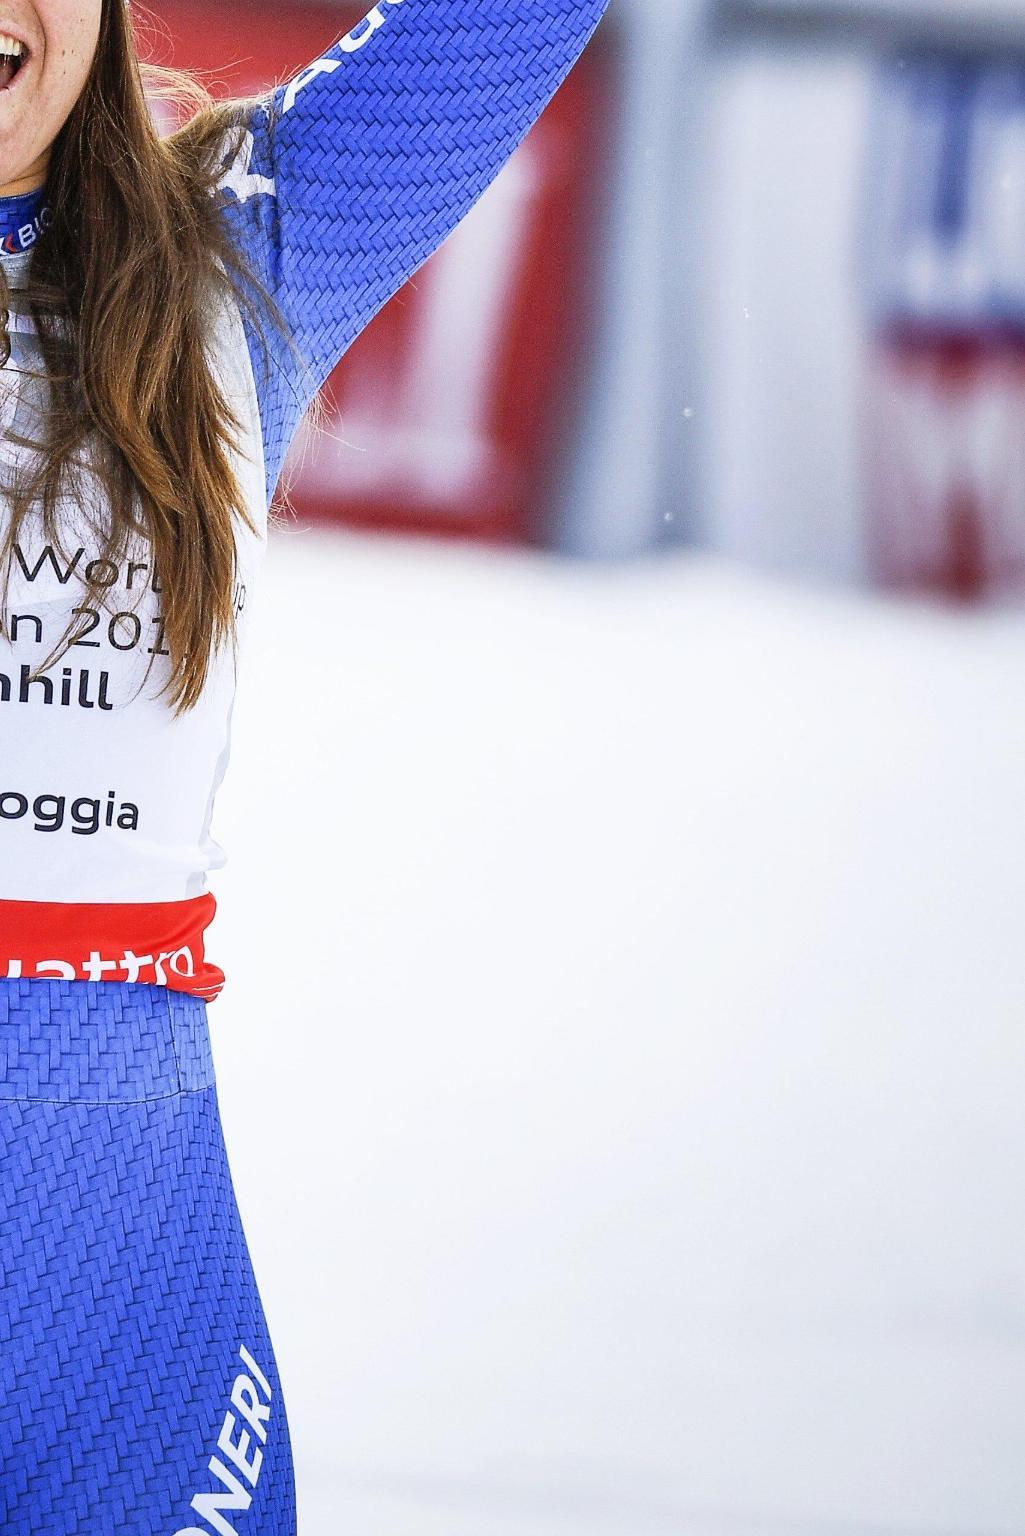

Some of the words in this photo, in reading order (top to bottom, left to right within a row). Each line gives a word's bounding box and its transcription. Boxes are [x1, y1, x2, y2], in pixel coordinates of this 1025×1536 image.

[13, 542, 163, 593] Worl
[68, 607, 170, 656] 201
[171, 1343, 273, 1536] NERI
